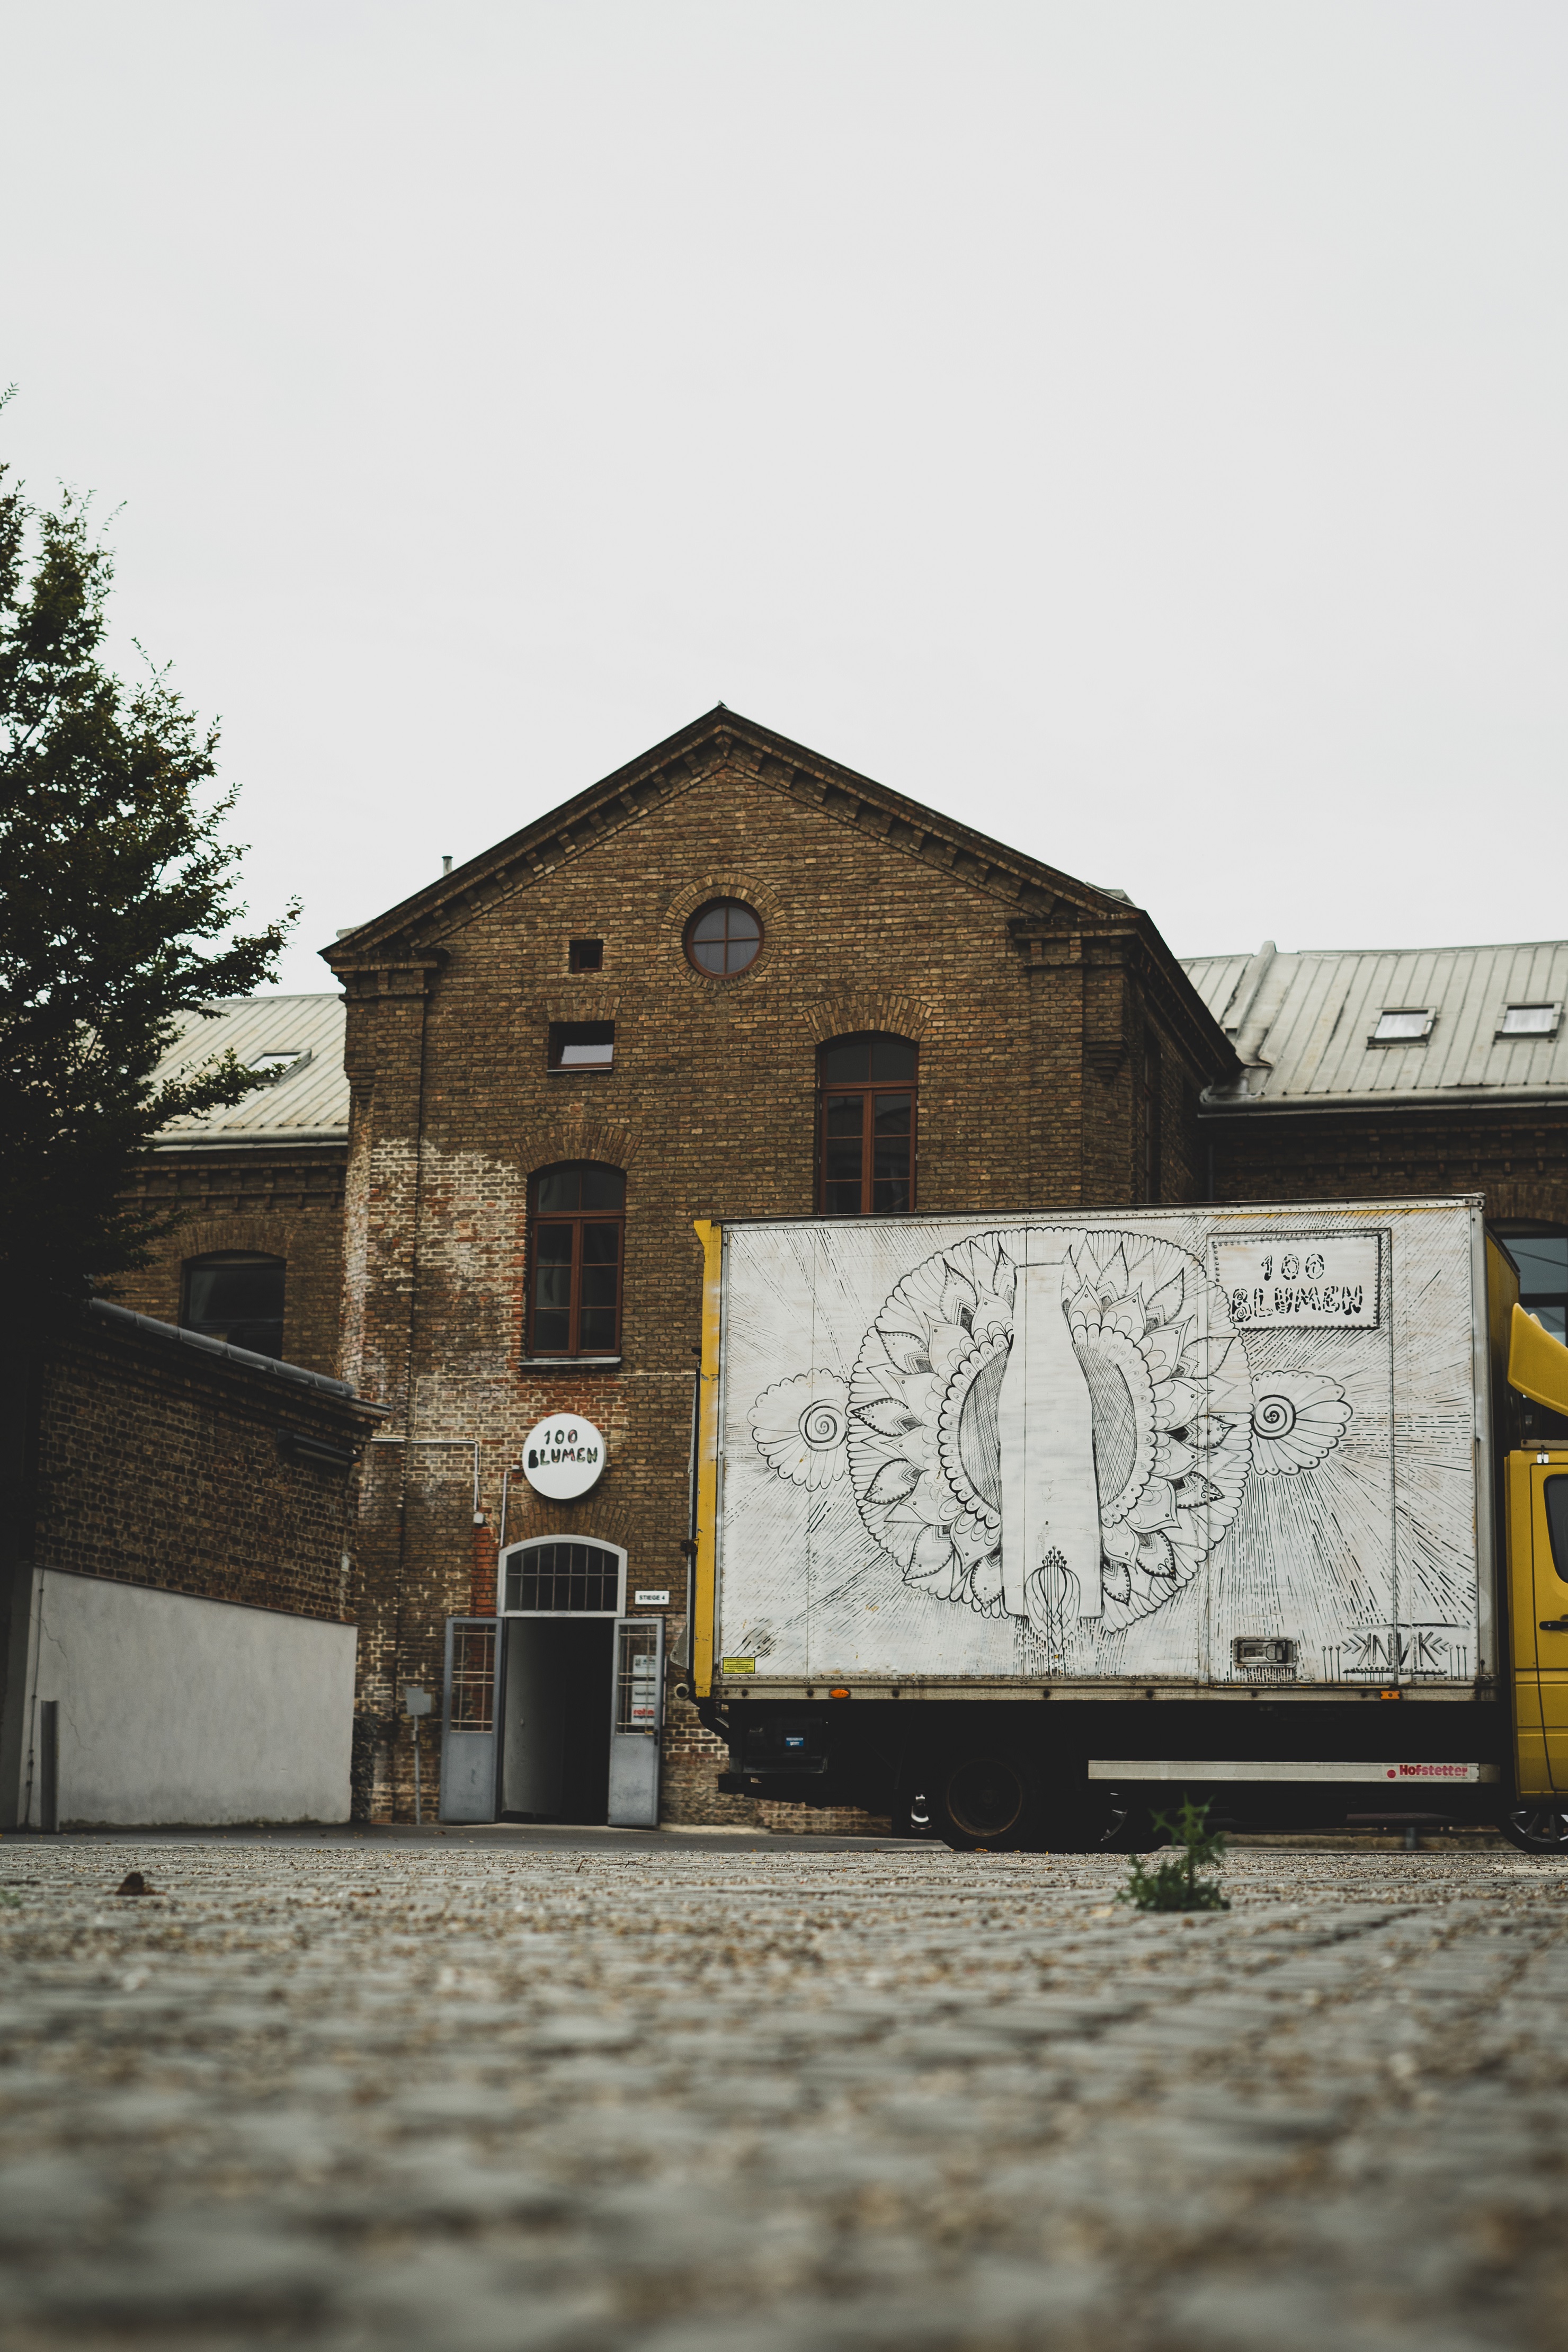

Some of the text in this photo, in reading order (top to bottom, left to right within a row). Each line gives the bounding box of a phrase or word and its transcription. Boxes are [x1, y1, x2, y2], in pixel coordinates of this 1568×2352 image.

[1261, 1253, 1324, 1281] 100
[1232, 1285, 1363, 1323] BLUMEN
[544, 1429, 578, 1445] 100
[528, 1447, 598, 1469] BLUMEN
[1399, 1764, 1468, 1777] Hofstetter
